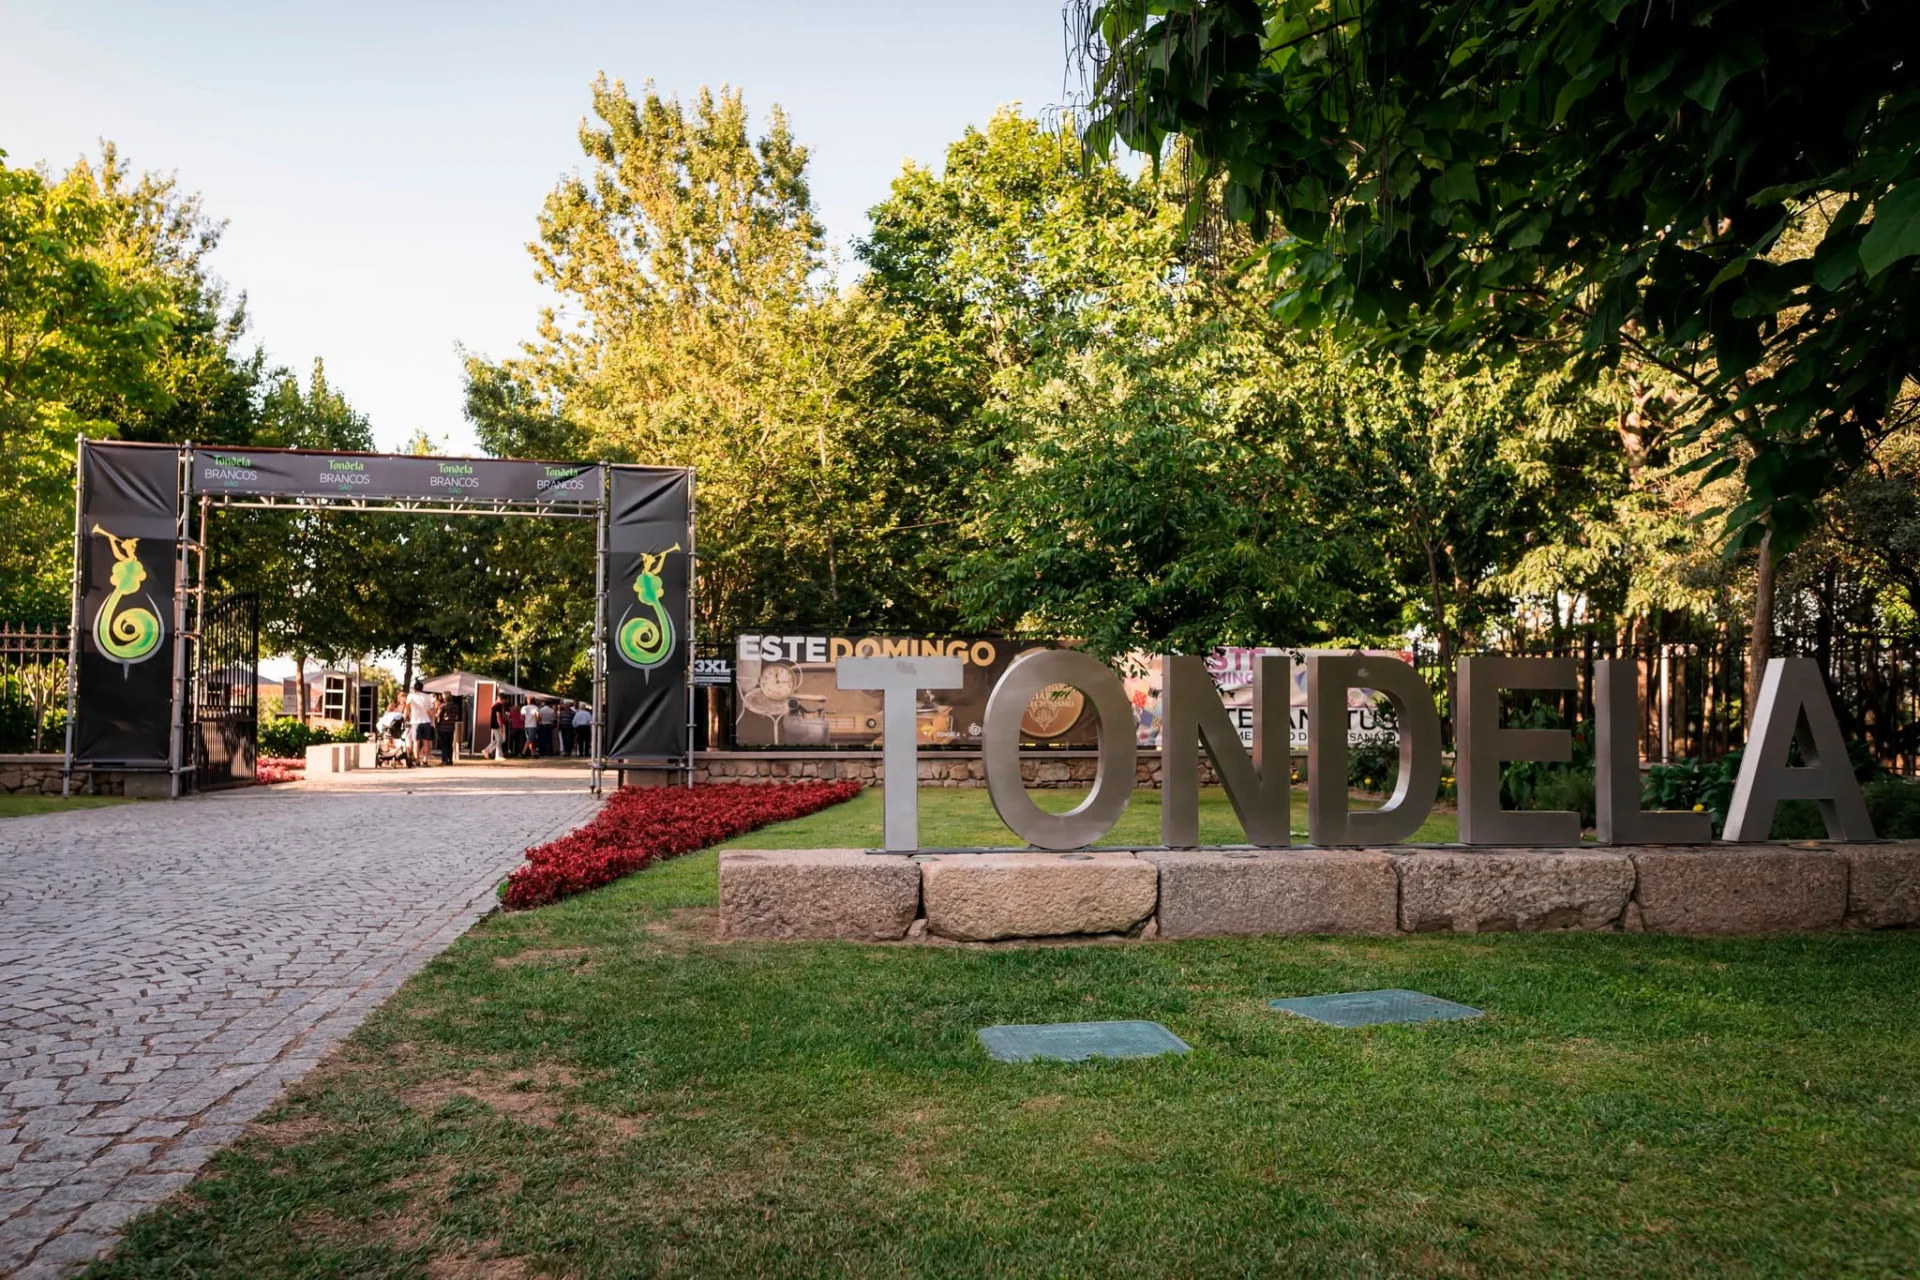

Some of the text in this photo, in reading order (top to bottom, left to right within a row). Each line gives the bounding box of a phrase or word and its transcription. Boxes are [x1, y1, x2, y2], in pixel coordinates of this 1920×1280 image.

[213, 455, 251, 467] Tondela
[328, 460, 364, 471] Tondela
[438, 463, 473, 474] Tondela
[204, 468, 258, 481] BRANCOS
[320, 473, 370, 484] BRANCOS
[430, 476, 479, 488] BRANCOS
[536, 480, 584, 490] BRANCOS
[836, 649, 1877, 850] TONDELA
